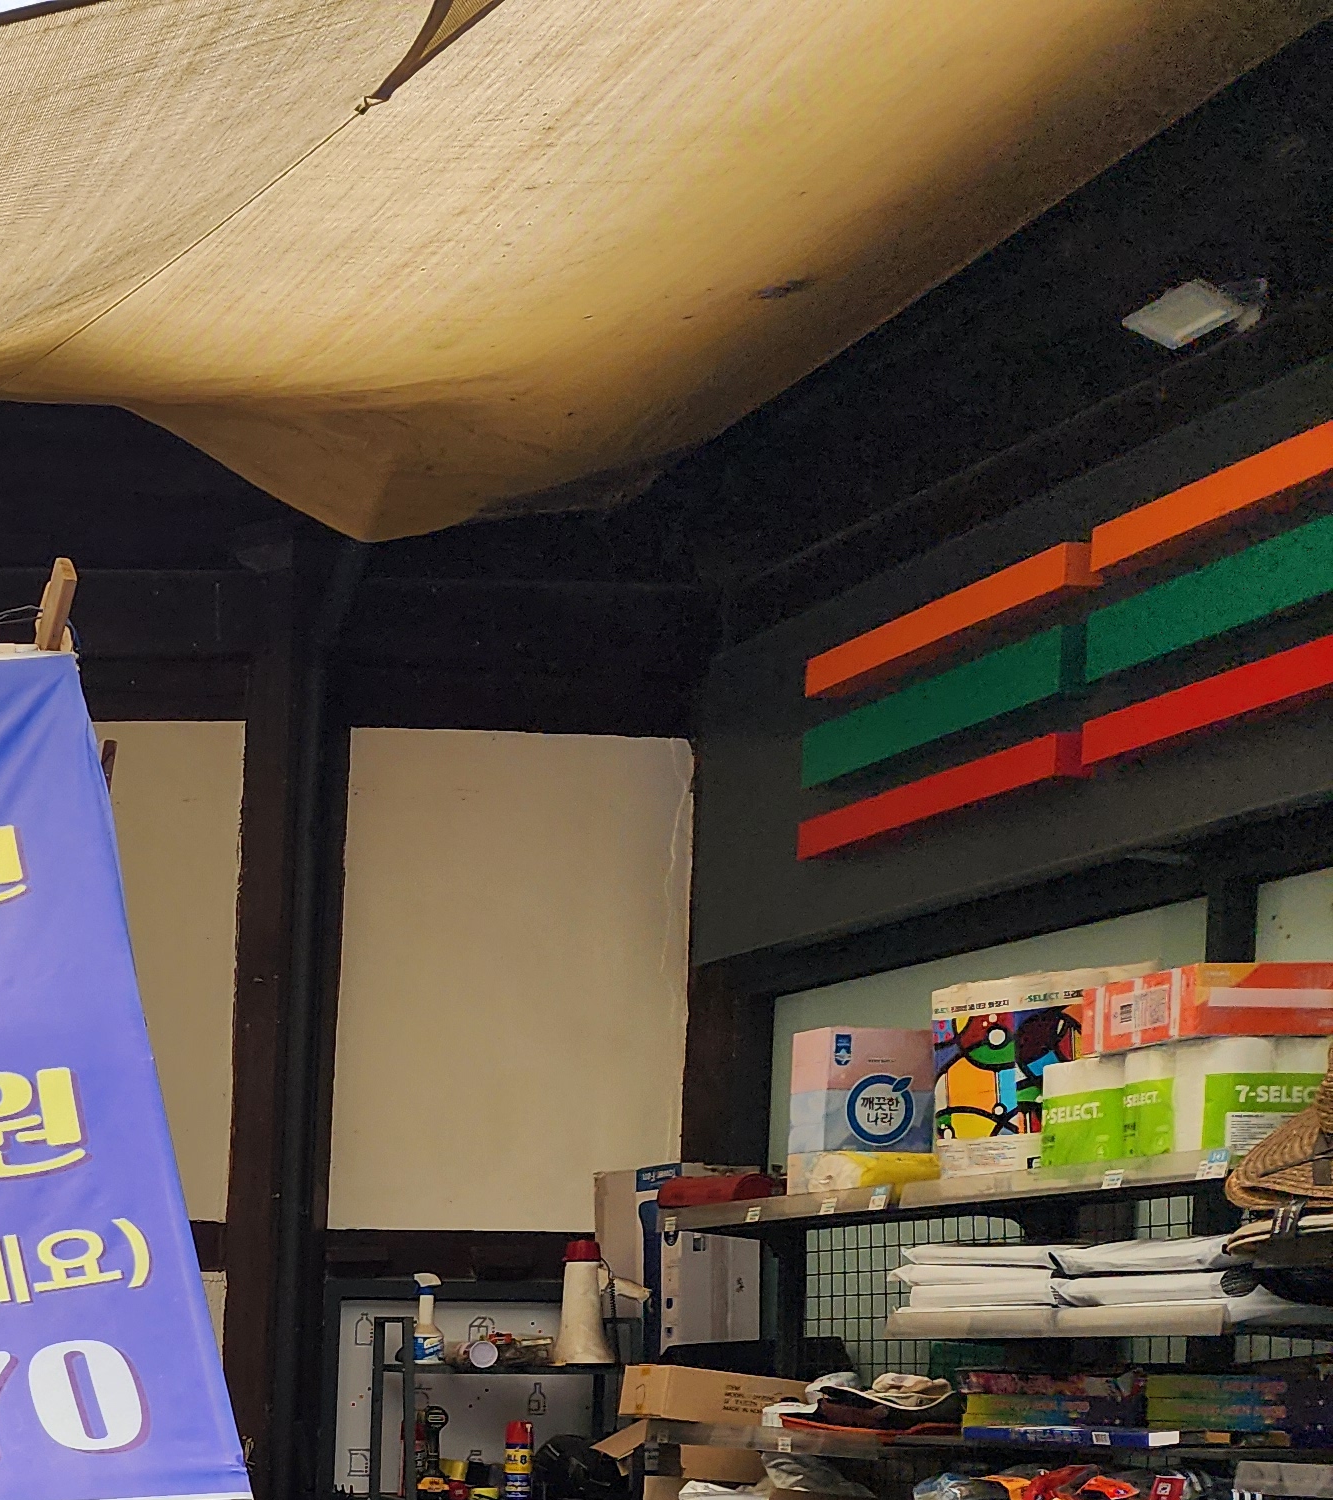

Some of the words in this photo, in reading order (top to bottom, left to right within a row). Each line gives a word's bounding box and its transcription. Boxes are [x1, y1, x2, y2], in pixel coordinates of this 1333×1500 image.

[1235, 1084, 1320, 1104] 7-SELEC
[860, 1096, 901, 1112] 깨끗한
[866, 1112, 895, 1127] 나라
